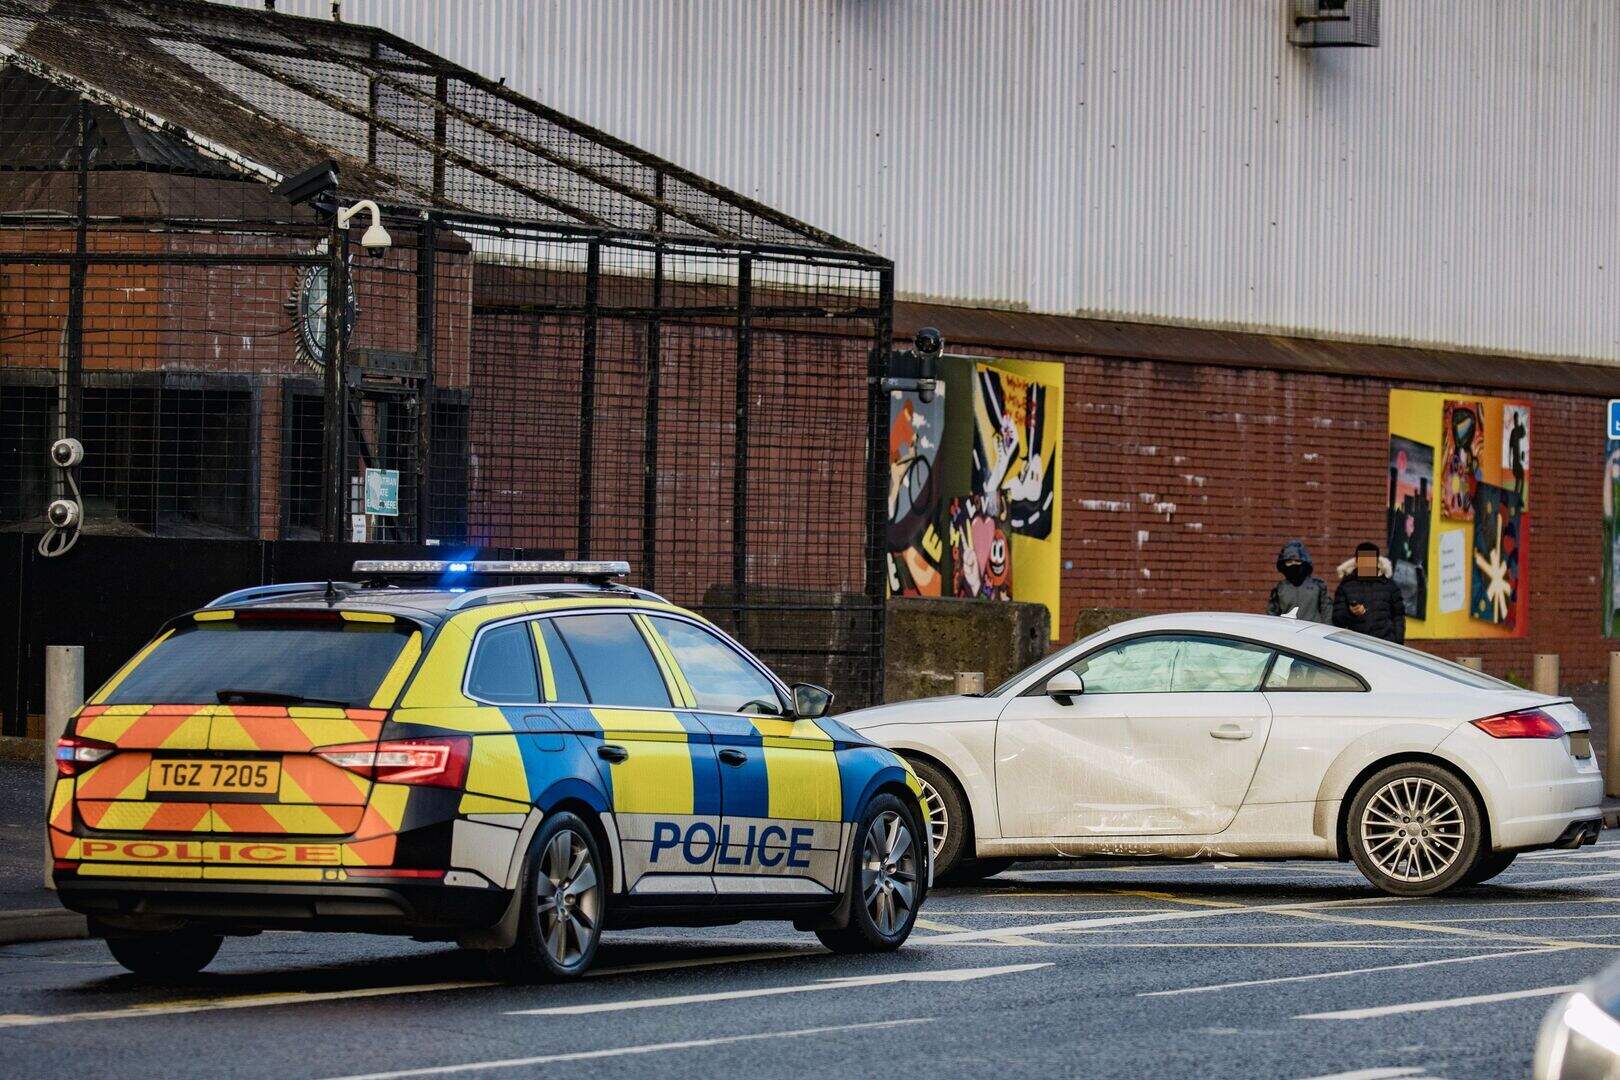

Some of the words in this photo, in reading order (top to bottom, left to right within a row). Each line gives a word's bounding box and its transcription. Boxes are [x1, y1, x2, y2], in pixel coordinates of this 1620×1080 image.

[161, 764, 203, 786] TGZ
[211, 764, 268, 788] 7205
[81, 841, 339, 863] POLICE
[650, 821, 814, 868] POLICE
